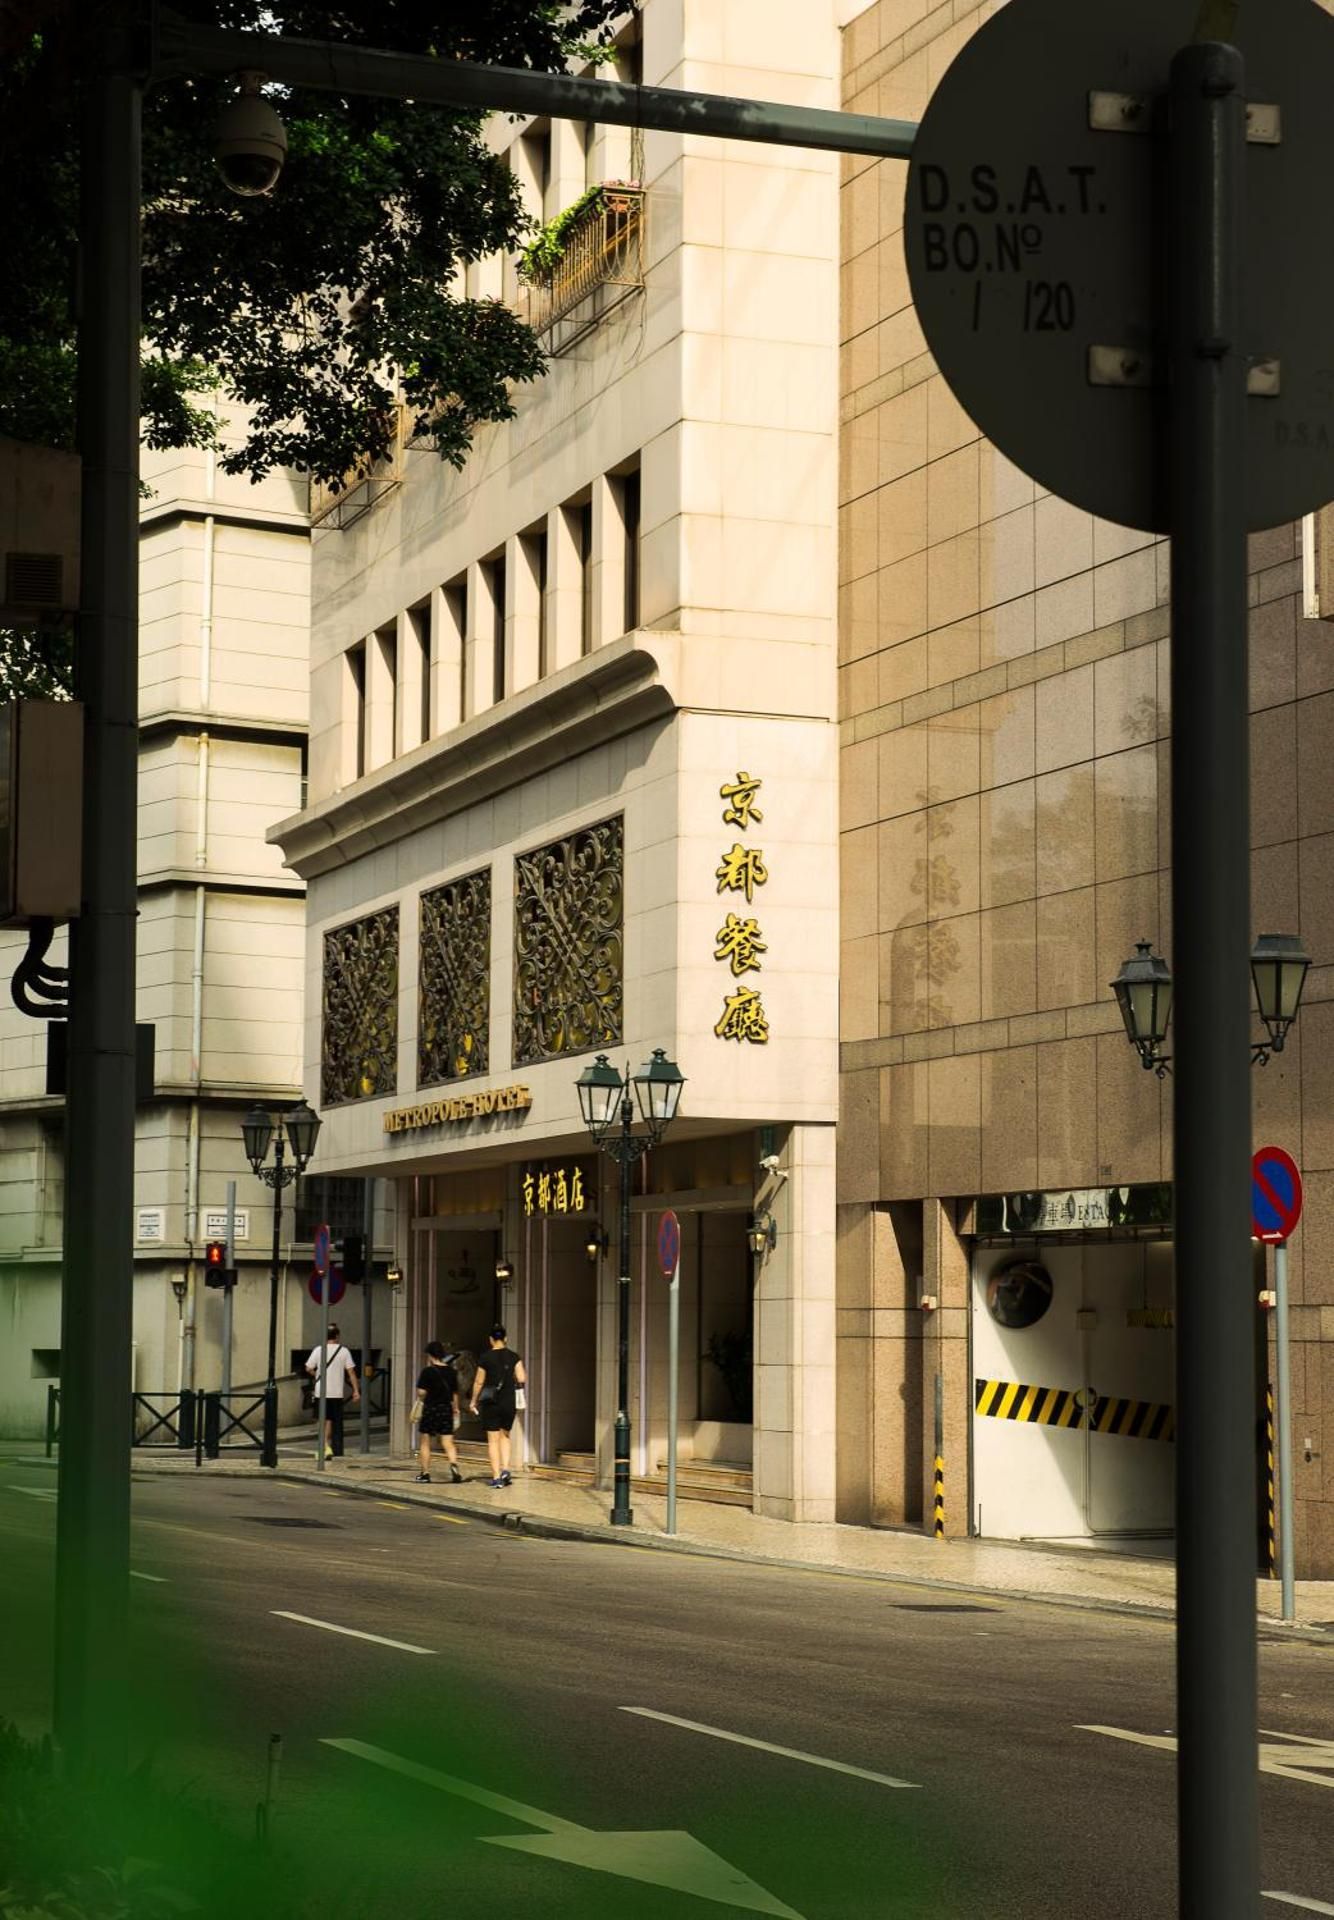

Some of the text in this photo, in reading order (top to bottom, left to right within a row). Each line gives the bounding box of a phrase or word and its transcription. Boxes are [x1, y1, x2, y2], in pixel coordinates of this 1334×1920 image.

[918, 164, 1107, 214] D.S.A.T.
[714, 771, 769, 1045] 京都餐廳
[383, 1085, 533, 1133] METROPOLE HOTEL
[522, 1166, 584, 1217] 京都酒店
